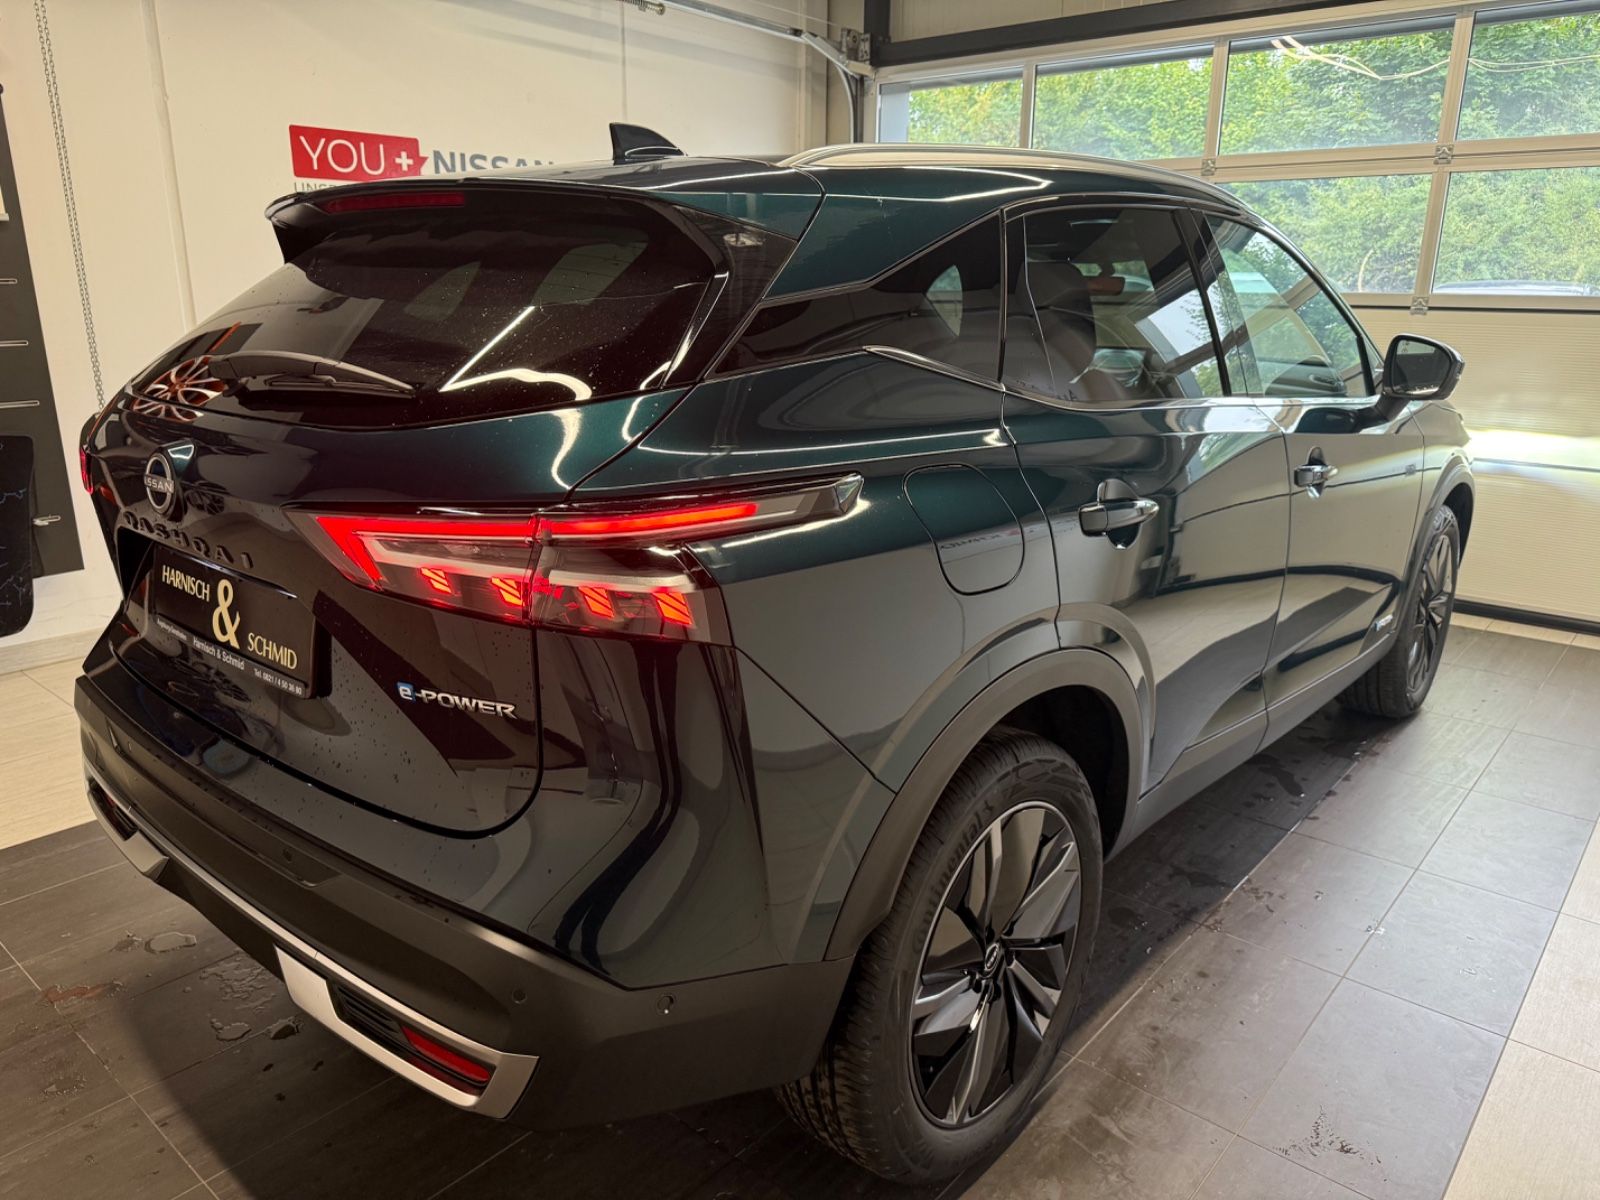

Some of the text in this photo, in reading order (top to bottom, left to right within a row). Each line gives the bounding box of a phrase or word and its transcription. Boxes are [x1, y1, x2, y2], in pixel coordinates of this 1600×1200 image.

[299, 135, 385, 175] YOU
[433, 150, 554, 175] NISS
[123, 510, 255, 569] QASHQAI
[161, 564, 211, 602] HARNISCH
[212, 578, 241, 650] &
[193, 636, 216, 656] Harnisch
[222, 651, 245, 670] Schmid
[247, 632, 298, 670] SCHMID
[397, 682, 518, 719] e-POWER
